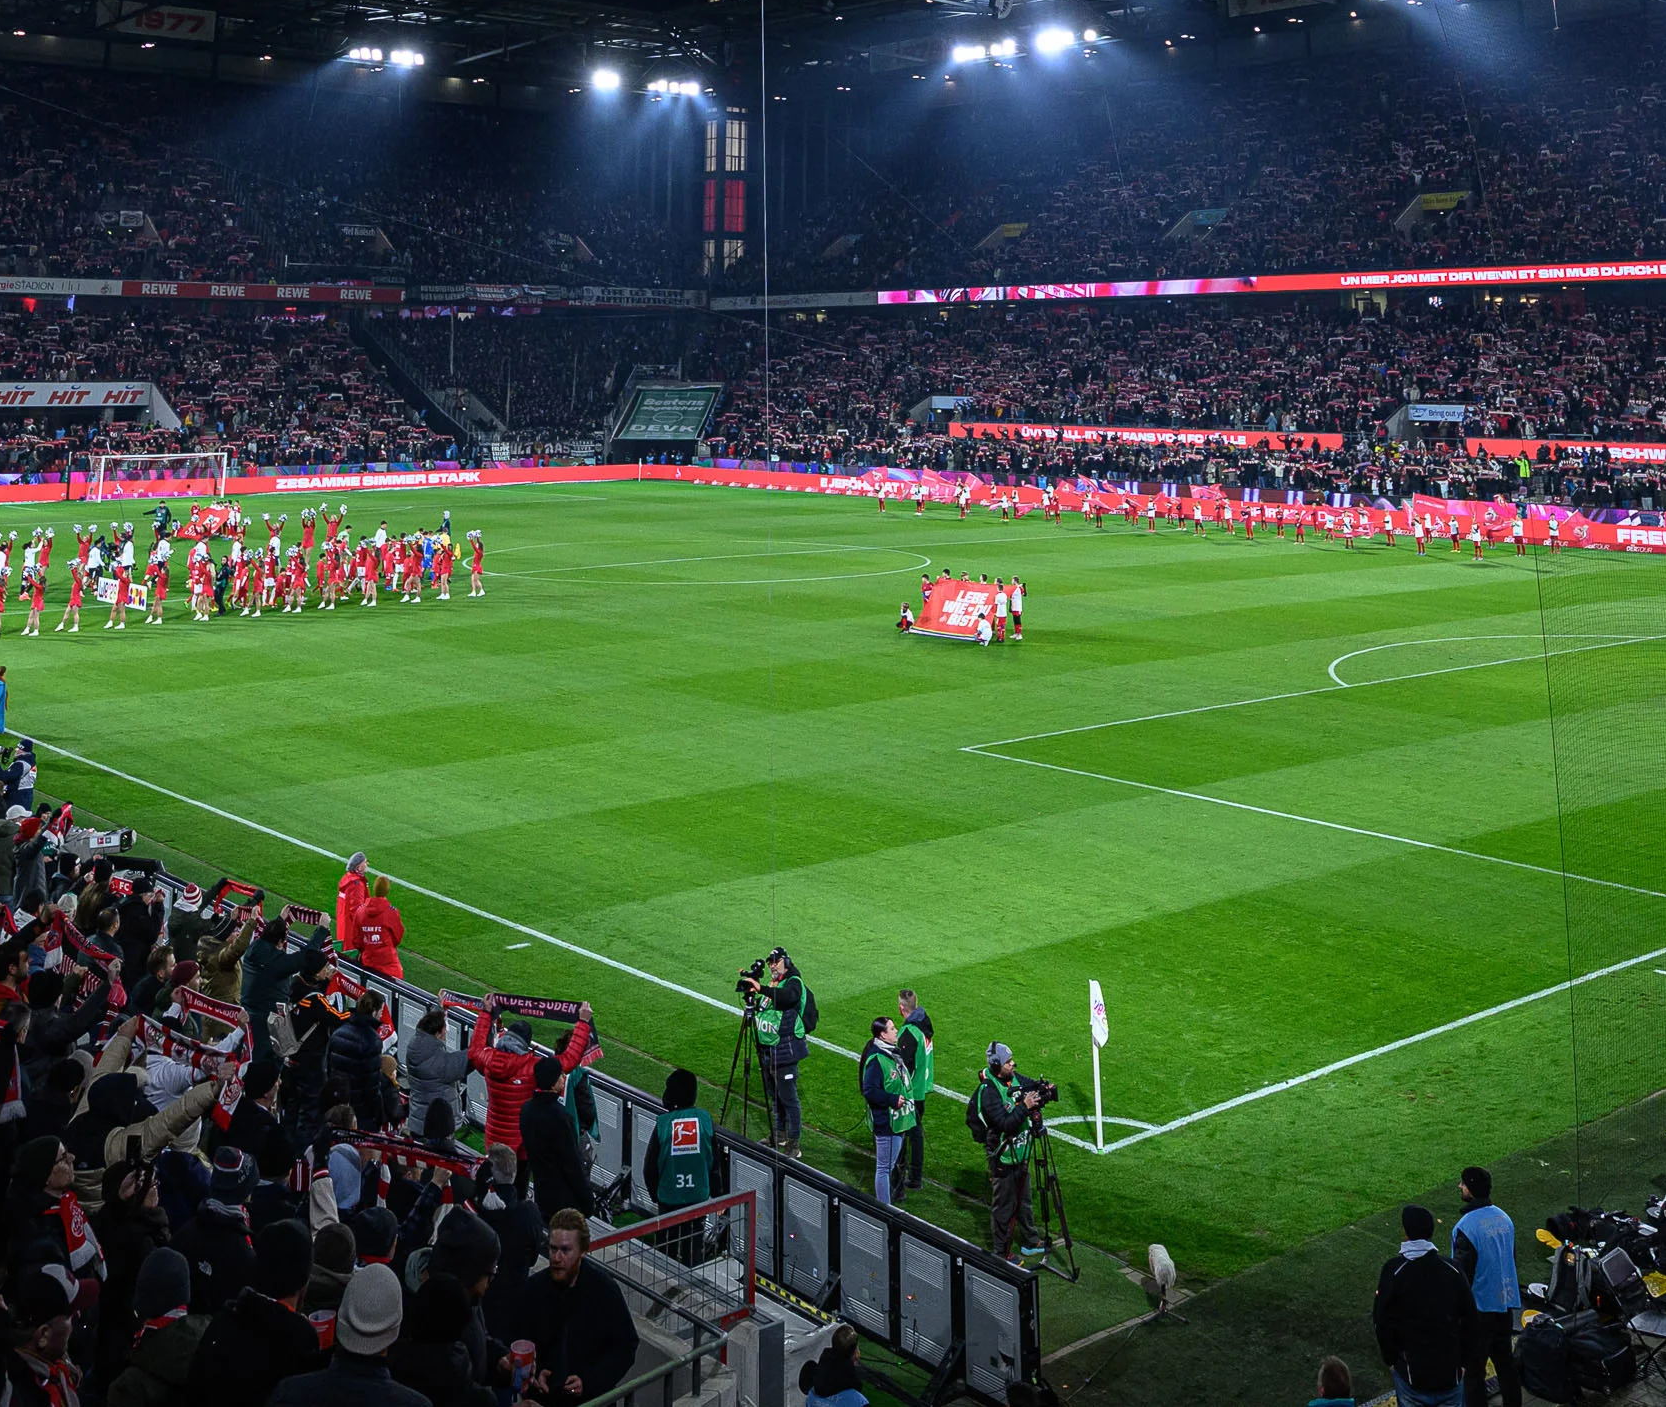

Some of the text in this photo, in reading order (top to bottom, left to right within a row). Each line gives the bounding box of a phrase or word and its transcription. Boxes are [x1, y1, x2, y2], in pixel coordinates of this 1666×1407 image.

[135, 9, 206, 33] 1977
[1341, 275, 1360, 285] UN
[1361, 274, 1389, 285] MER
[1390, 273, 1417, 284] JON
[1418, 272, 1447, 283] MET
[1449, 271, 1473, 282] DIR
[1474, 269, 1517, 281] WENN
[1519, 268, 1537, 280] ET
[1538, 267, 1568, 279] SIN
[1600, 263, 1659, 277] DURCH
[142, 283, 178, 295] REWE
[211, 285, 245, 297] REWE
[276, 287, 310, 299] REWE
[340, 289, 372, 300] REWE
[47, 389, 91, 405] HIT
[103, 388, 145, 404] HIT
[1428, 409, 1446, 419] Bring
[629, 424, 695, 433] DEVK
[1122, 431, 1156, 443] FANS
[1187, 434, 1208, 444] FC
[276, 471, 481, 489] ZESAMME SIMMER STARK
[956, 590, 990, 603] LEBE
[942, 600, 993, 616] WIE DU
[946, 613, 979, 627] BIST
[675, 1174, 695, 1188] 31
